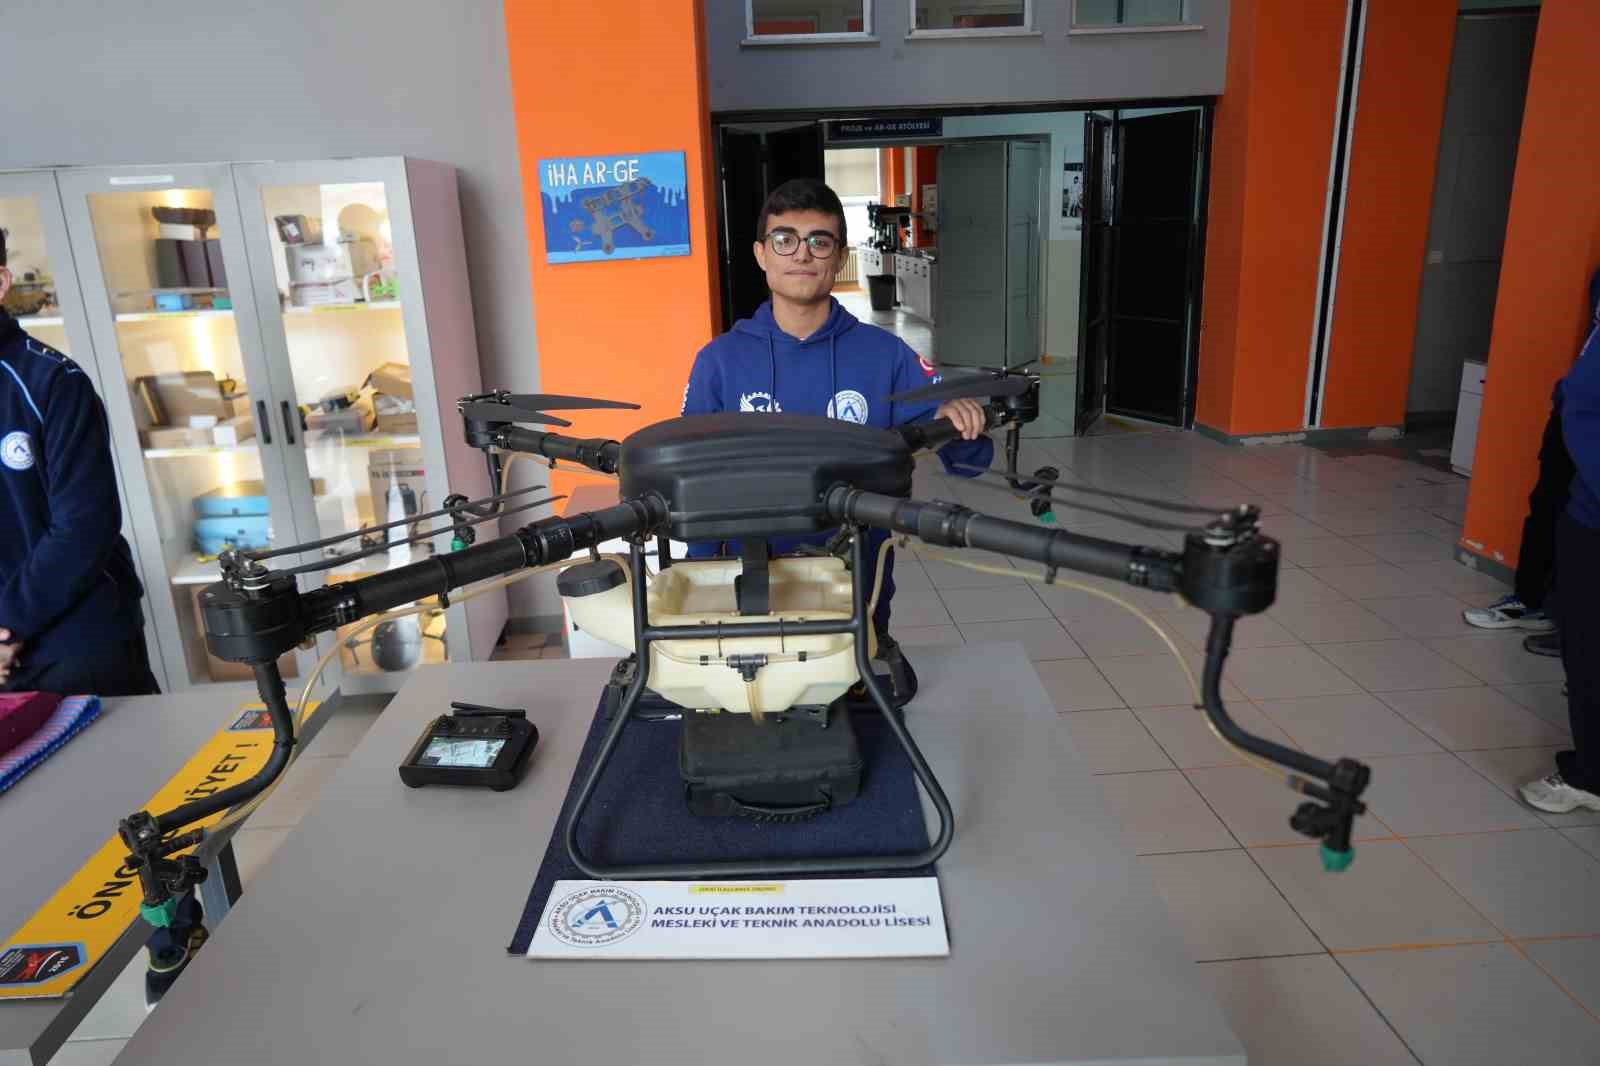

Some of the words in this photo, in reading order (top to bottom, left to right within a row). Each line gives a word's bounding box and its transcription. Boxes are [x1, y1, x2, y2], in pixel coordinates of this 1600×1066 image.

[583, 159, 640, 185] AR-GE
[653, 906, 695, 915] AKSU
[699, 906, 741, 917] UÇAK
[744, 905, 795, 915] BAKIM
[799, 904, 896, 914] TEKNOLOJİSİ
[651, 918, 717, 928] MESLEKİ
[720, 919, 740, 928] VE
[743, 918, 798, 928] TEKNİK
[802, 918, 880, 928] ANADOLU
[885, 916, 931, 927] LİSESİ
